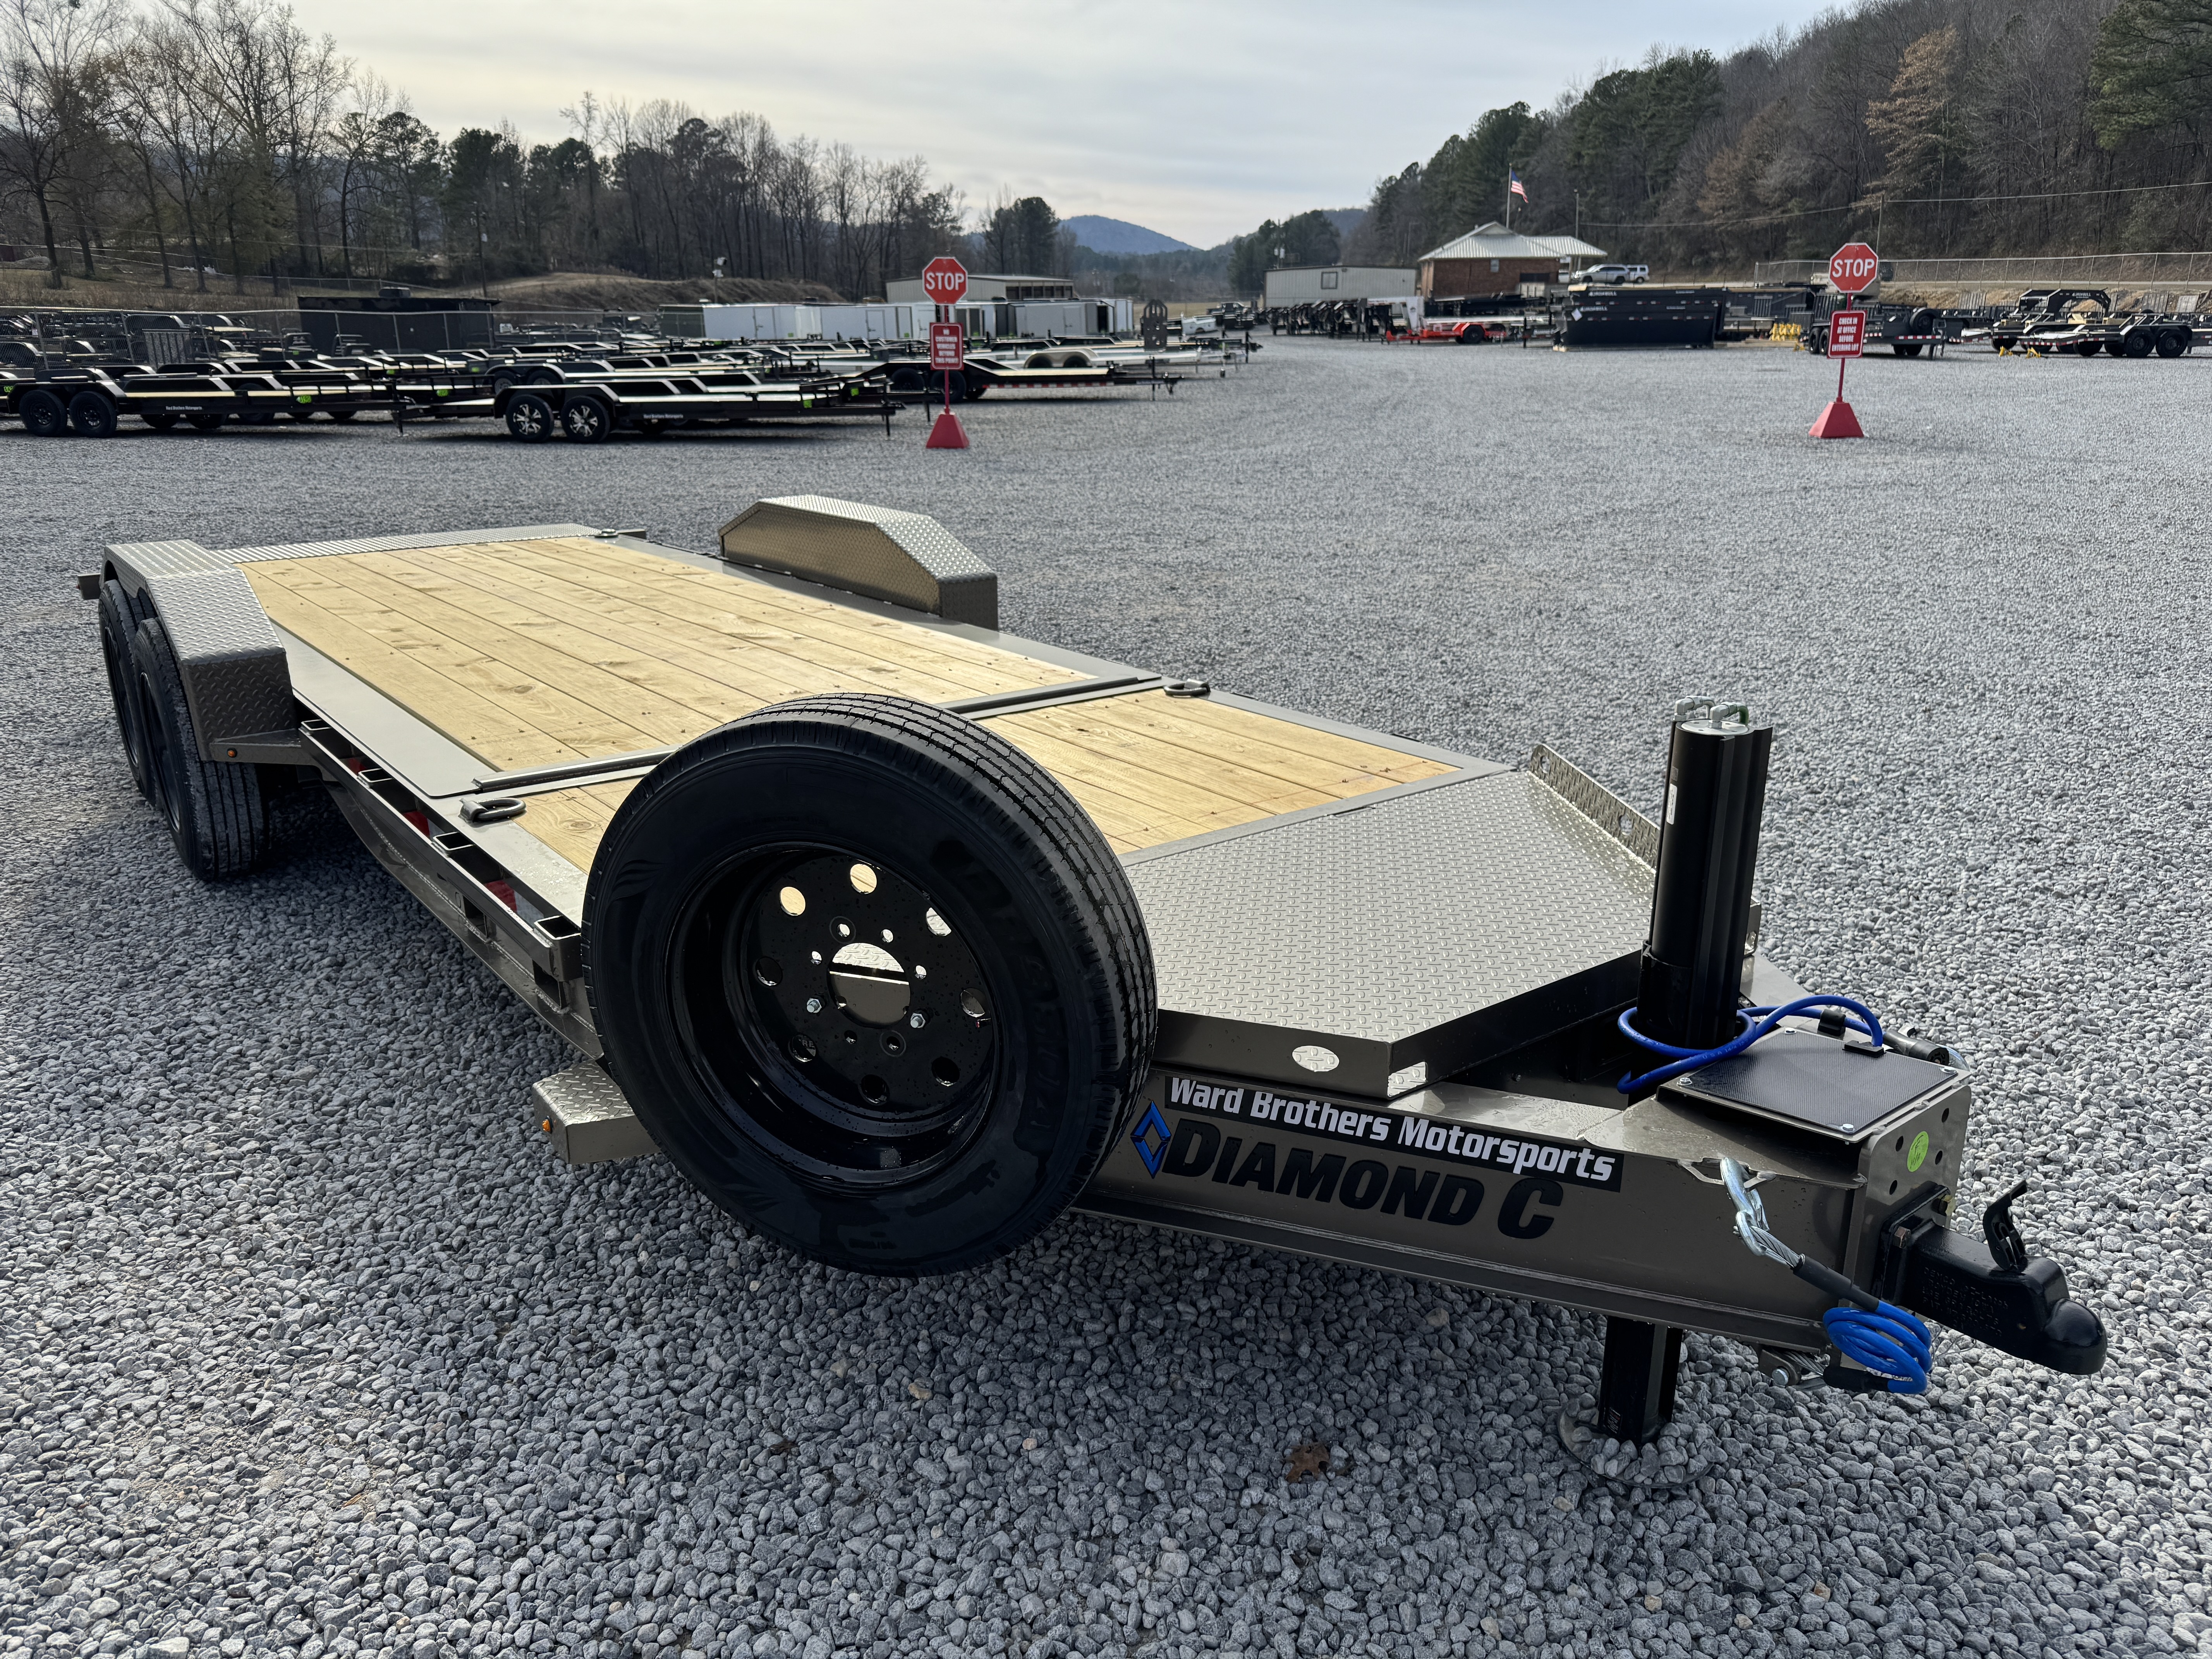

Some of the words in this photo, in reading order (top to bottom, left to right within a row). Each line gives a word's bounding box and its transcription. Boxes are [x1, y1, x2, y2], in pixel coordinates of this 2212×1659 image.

[1832, 258, 1875, 278] STOP
[926, 272, 965, 290] STOP
[1839, 317, 1852, 325] CHECK
[1843, 326, 1856, 334] OFFICE
[1839, 335, 1854, 343] BEFORE
[1832, 343, 1851, 352] ENTERING
[1171, 1077, 1244, 1114] Ward
[1250, 1091, 1391, 1141] Brothers
[1398, 1116, 1615, 1182] Motorsports
[1161, 1118, 1485, 1226] DIAMOND
[1498, 1177, 1564, 1239] C
